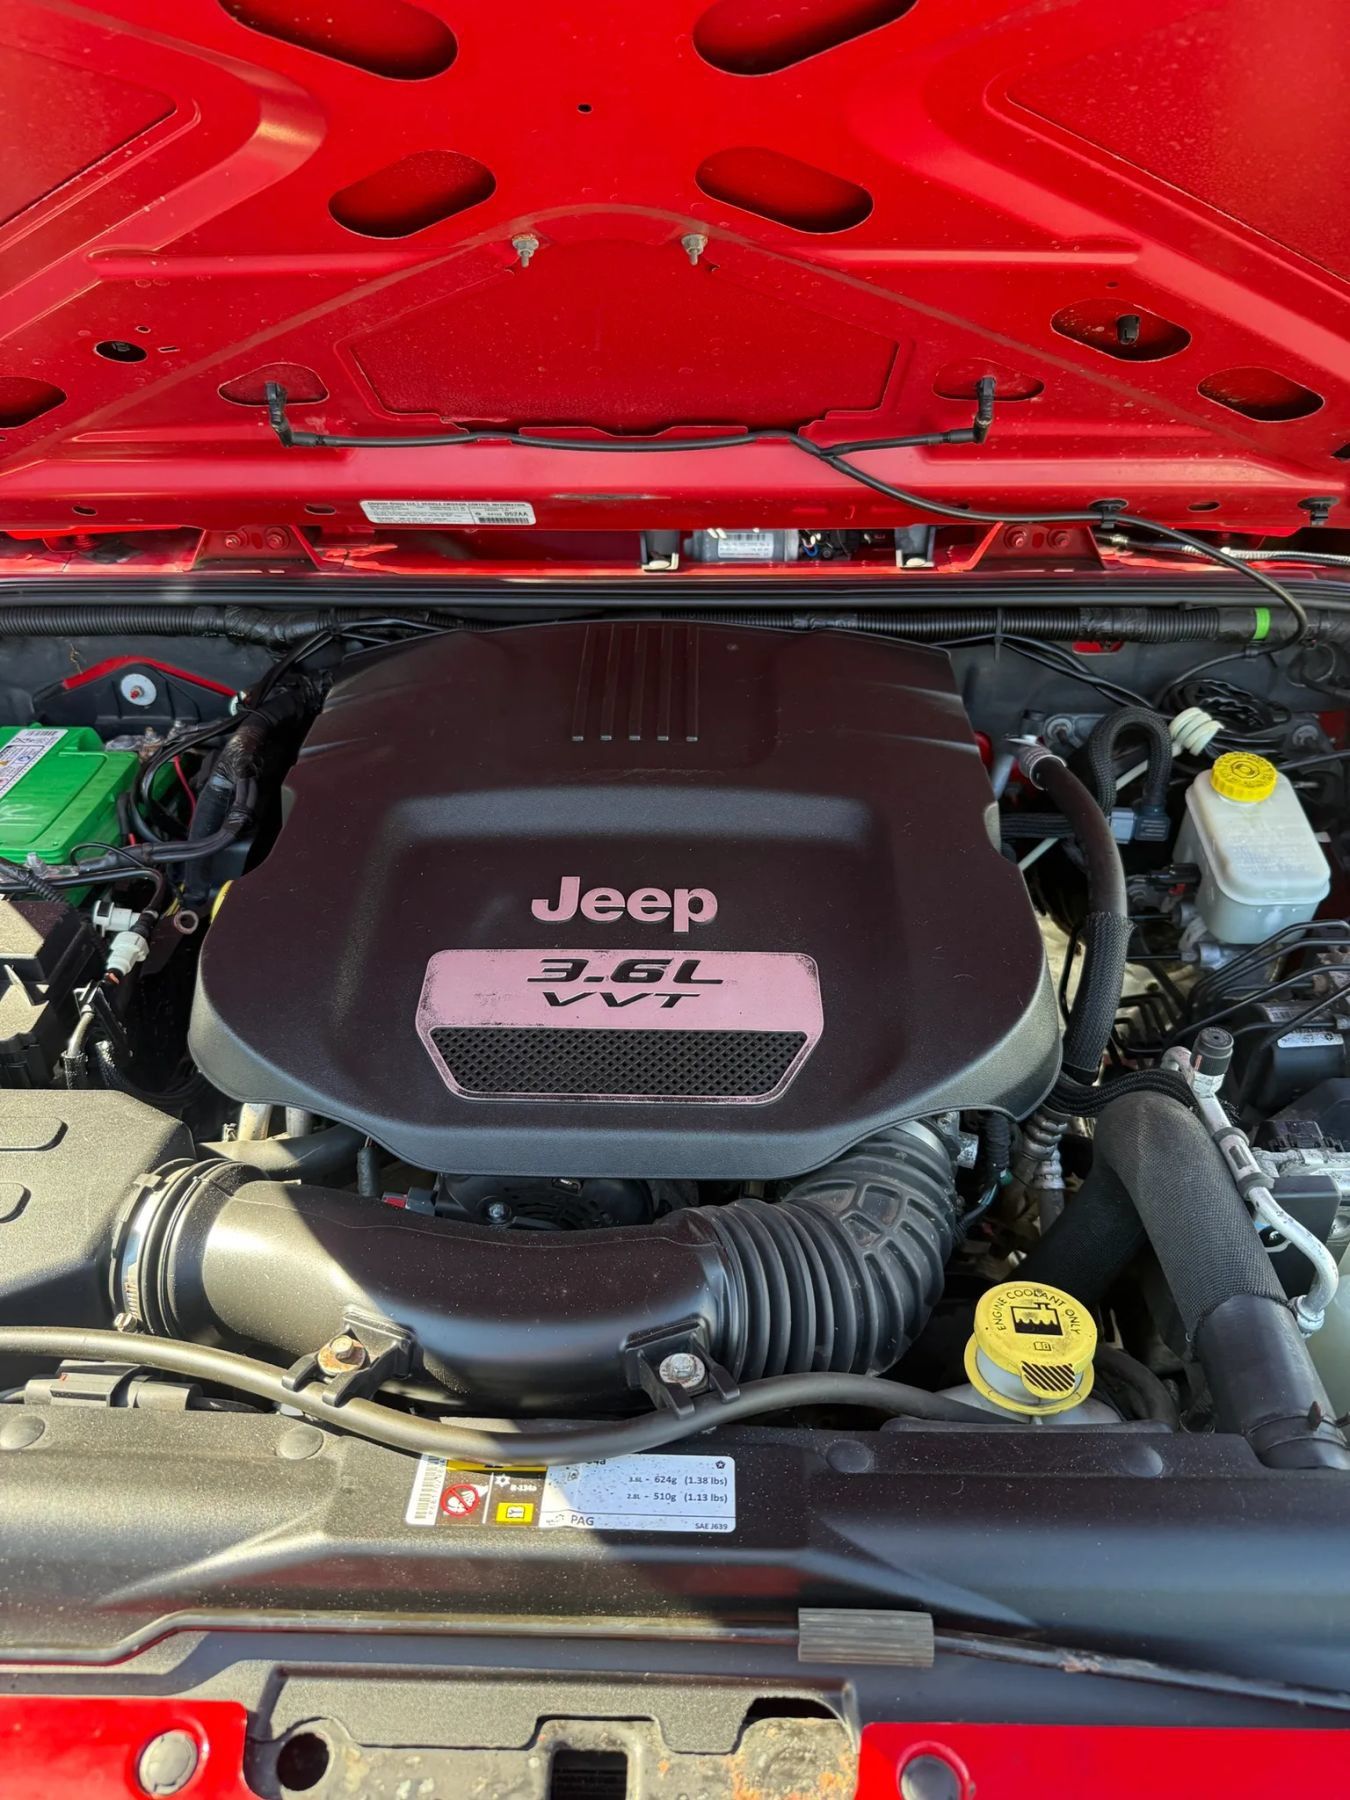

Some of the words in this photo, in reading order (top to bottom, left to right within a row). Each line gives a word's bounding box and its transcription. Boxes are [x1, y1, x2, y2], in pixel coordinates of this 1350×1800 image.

[530, 876, 719, 933] Jeep
[527, 958, 724, 984] 3.6L
[541, 991, 701, 1009] VVT
[992, 1297, 1007, 1331] ENGINE
[1006, 1288, 1066, 1307] COOLANT
[1064, 1308, 1081, 1335] ONLY
[654, 1476, 677, 1485] 624g
[684, 1476, 708, 1486] (1.38
[711, 1477, 728, 1486] lbs)
[653, 1493, 677, 1502] 510g
[684, 1493, 708, 1502] (1.13
[711, 1494, 728, 1503] lbs)
[570, 1515, 594, 1526] PAG
[695, 1522, 708, 1530] SAE
[710, 1523, 728, 1531] J639
